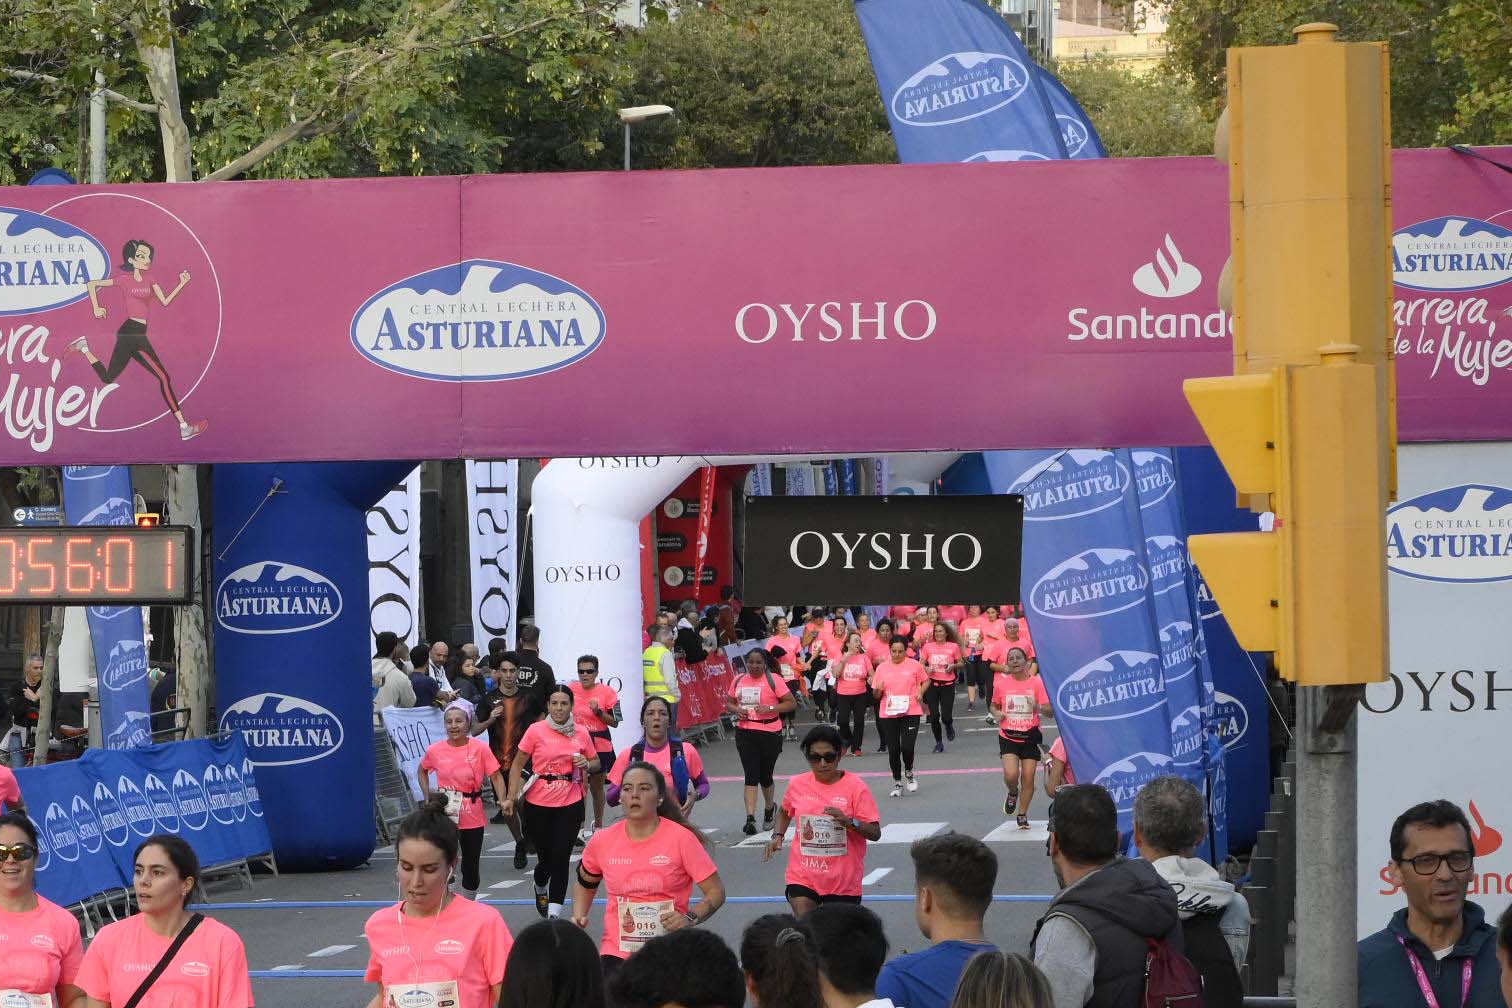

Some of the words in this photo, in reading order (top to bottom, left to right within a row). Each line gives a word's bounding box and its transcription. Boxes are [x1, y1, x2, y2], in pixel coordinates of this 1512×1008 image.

[13, 243, 86, 254] LECHERA
[409, 302, 489, 316] CENTRAL
[496, 300, 578, 314] LECHERA
[1394, 298, 1488, 326] arrera
[370, 307, 587, 352] ASTURIANA
[734, 299, 938, 344] OYSHO
[1067, 307, 1233, 341] Santand
[1417, 328, 1434, 354] la
[1430, 321, 1512, 385] Muje
[1414, 519, 1481, 529] CENTRAL
[789, 531, 982, 572] OYSHO
[545, 563, 621, 585] OYSHO
[232, 585, 276, 595] CENTRAL
[280, 584, 330, 594] LECHERA
[220, 592, 333, 618] ASTURIANA
[234, 717, 277, 726] CENTRAL
[280, 716, 330, 726] LECHERA
[226, 724, 334, 748] TURIANA
